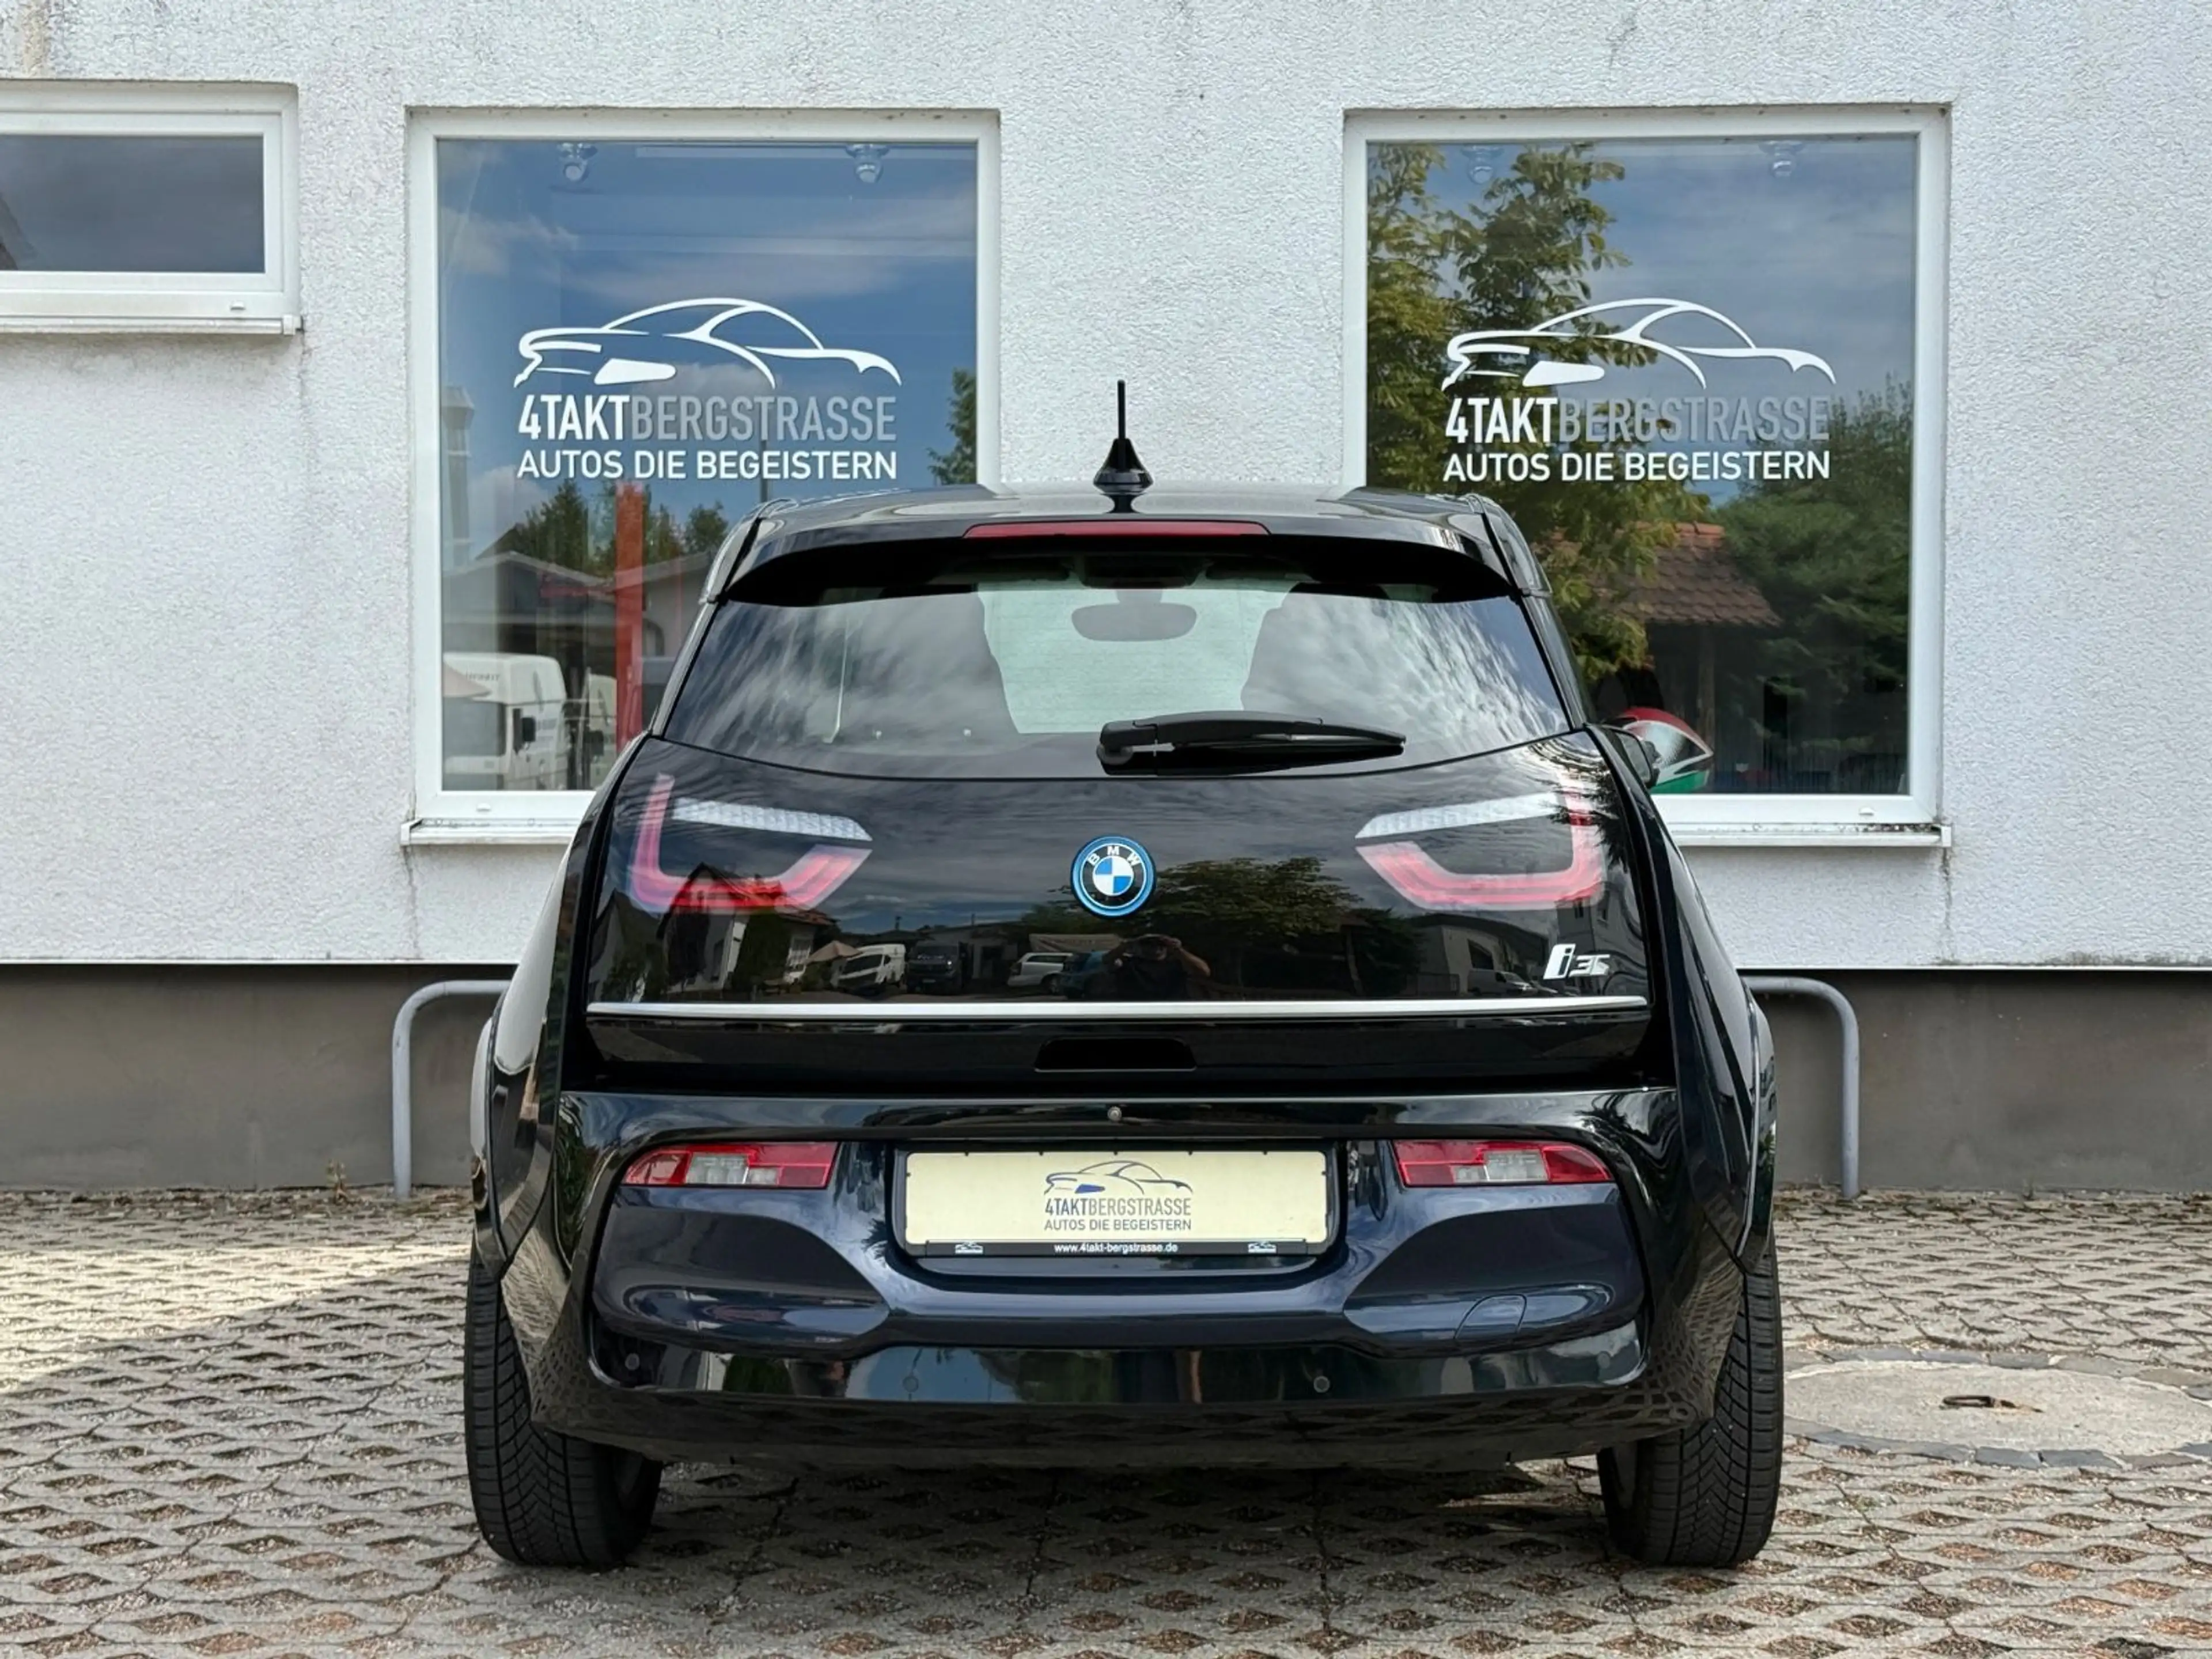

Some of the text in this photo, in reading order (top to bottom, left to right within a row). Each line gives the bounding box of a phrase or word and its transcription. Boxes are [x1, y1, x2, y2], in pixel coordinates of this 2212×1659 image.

[518, 394, 896, 441] 4TAKTBERGSTRASSE
[1445, 396, 1830, 443] 4TAKTBERGSTRASSE
[517, 450, 896, 479] AUTOS DIE BEGEISTERN
[1443, 450, 1830, 482] AUTOS DIE BEGEISTERN
[1087, 845, 1141, 866] BMW
[1045, 1198, 1191, 1215] 4TAKTBERGSTRASSE
[1044, 1219, 1191, 1231] AUTOS DIE BEGEISTERN
[1054, 1243, 1178, 1255] www.4takt-bergstrasse.de
